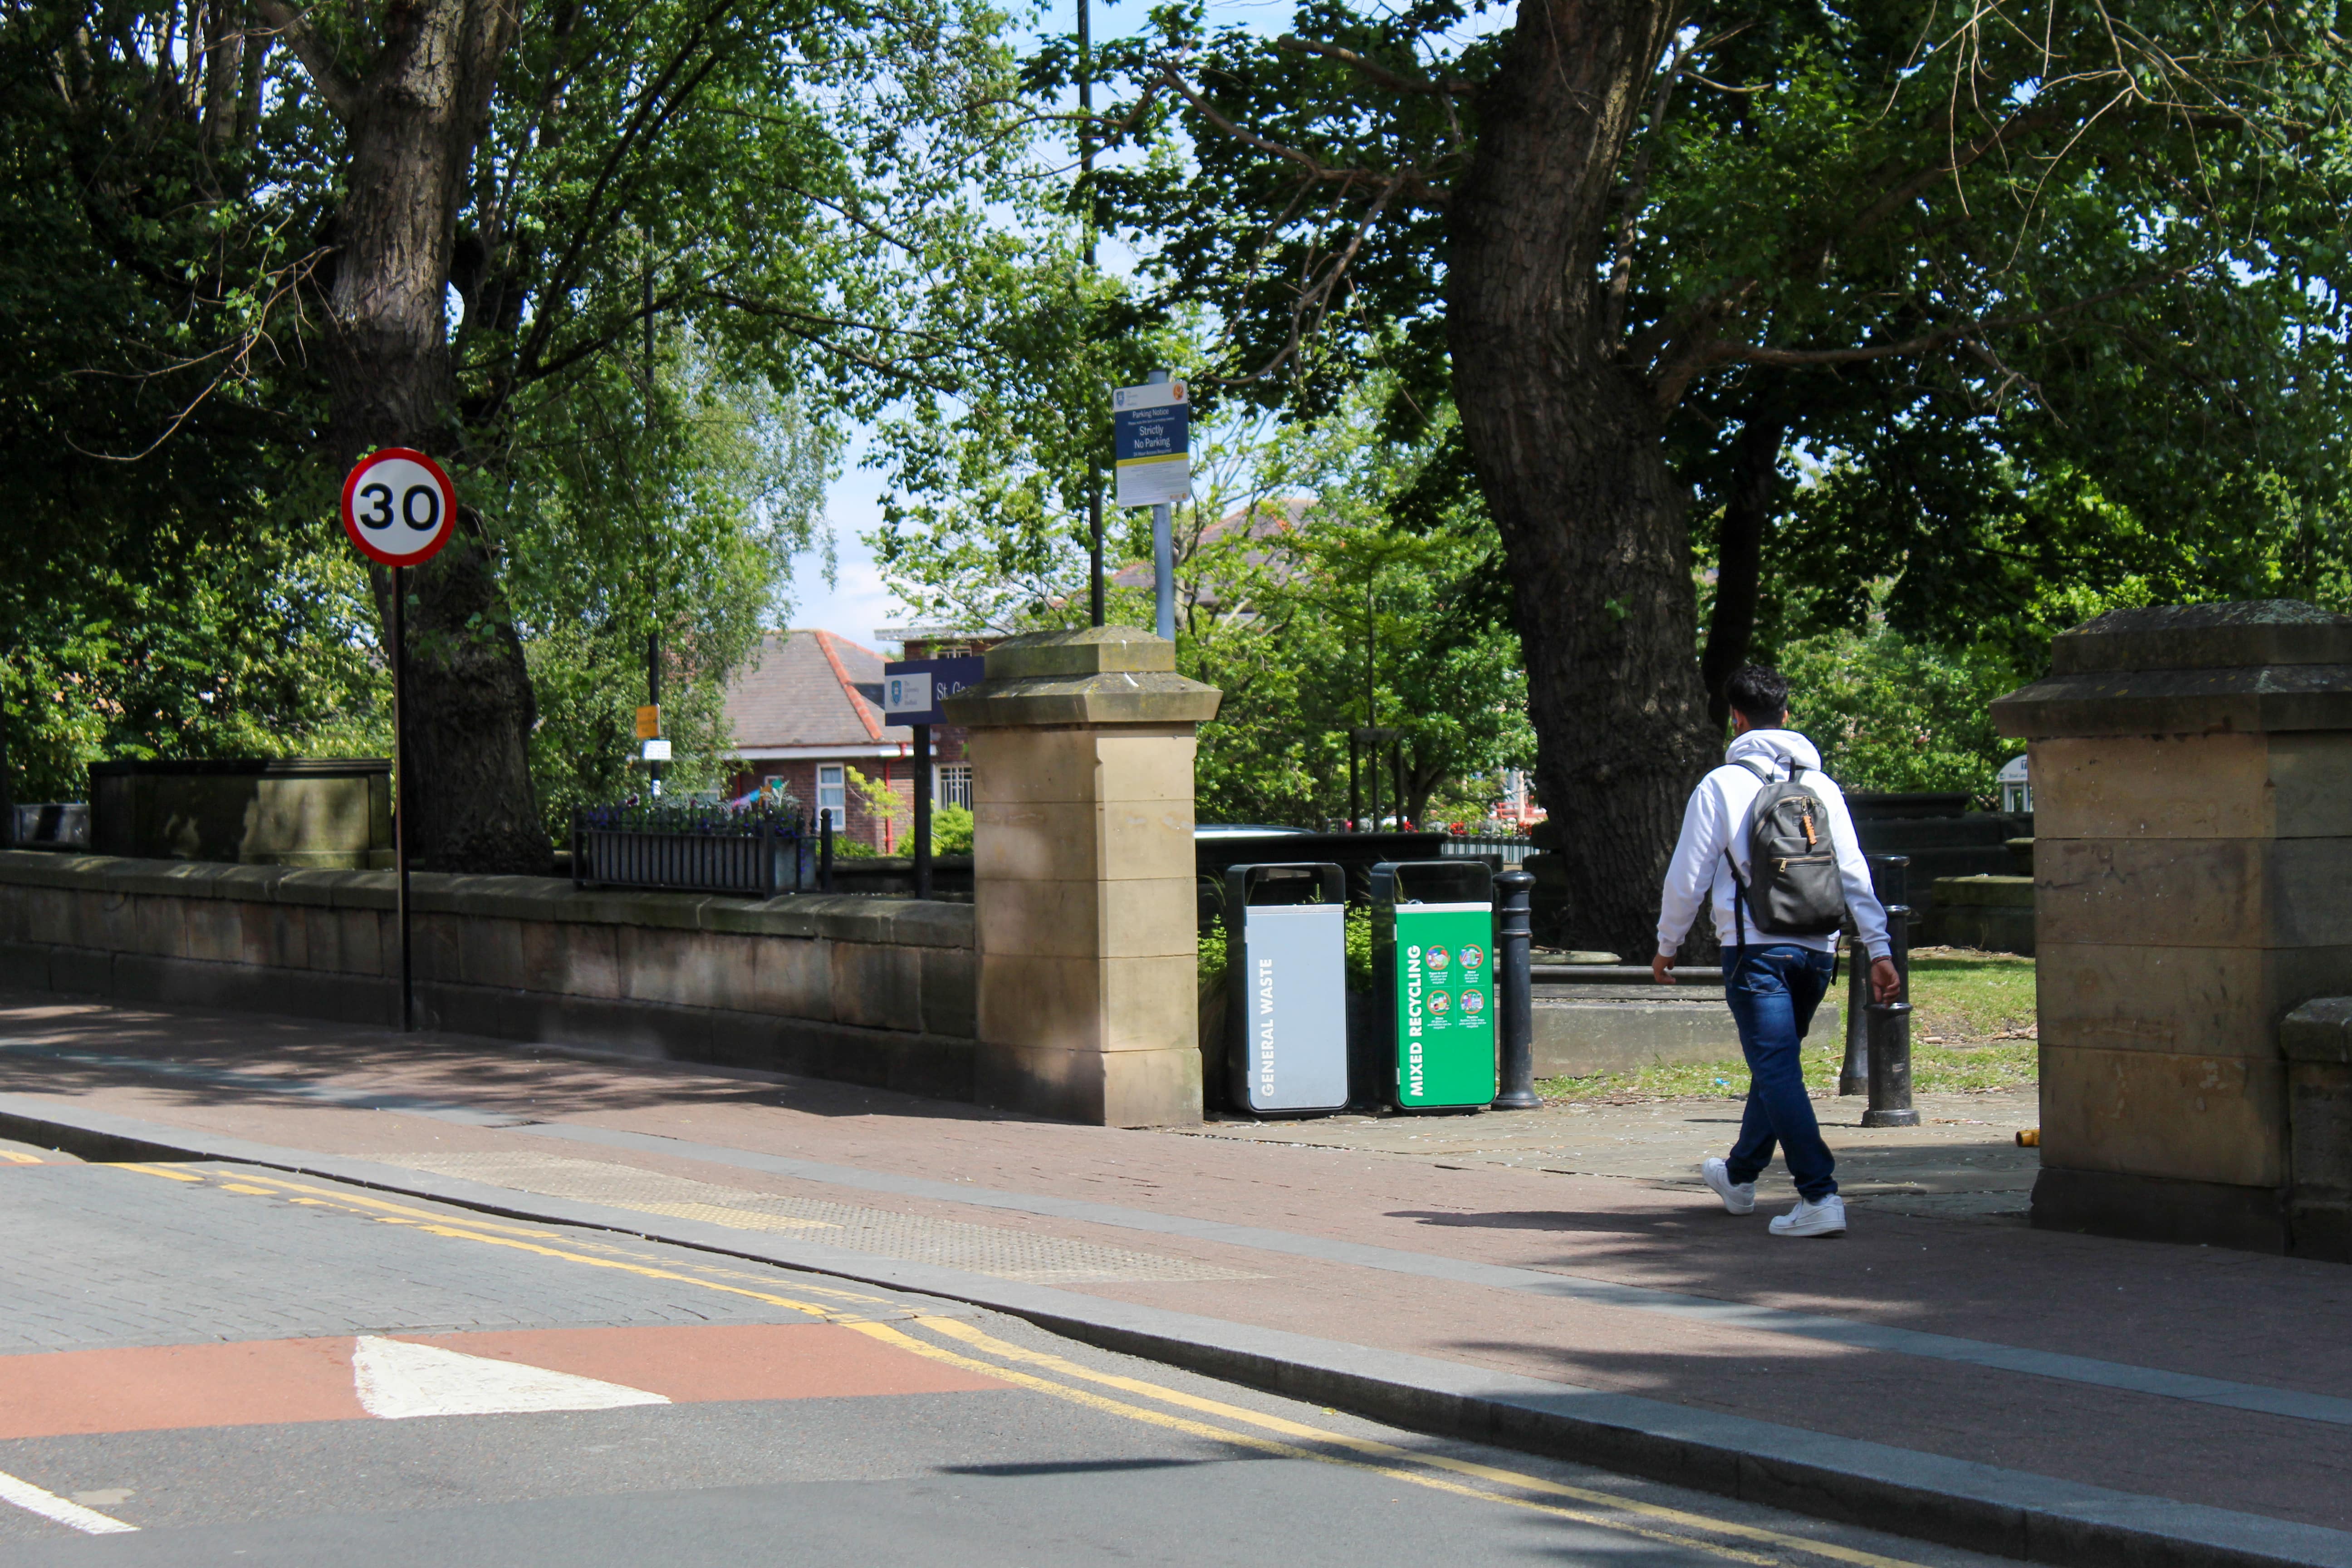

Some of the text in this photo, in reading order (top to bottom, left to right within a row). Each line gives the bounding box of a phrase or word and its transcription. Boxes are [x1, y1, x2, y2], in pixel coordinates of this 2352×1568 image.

[1132, 410, 1152, 419] Parking
[1135, 437, 1170, 449] No Parking
[1140, 425, 1163, 436] Strictly
[360, 482, 440, 531] 30
[1259, 959, 1274, 1097] GENERAL WASTE
[1407, 945, 1423, 1097] MIXED RECYCLING
